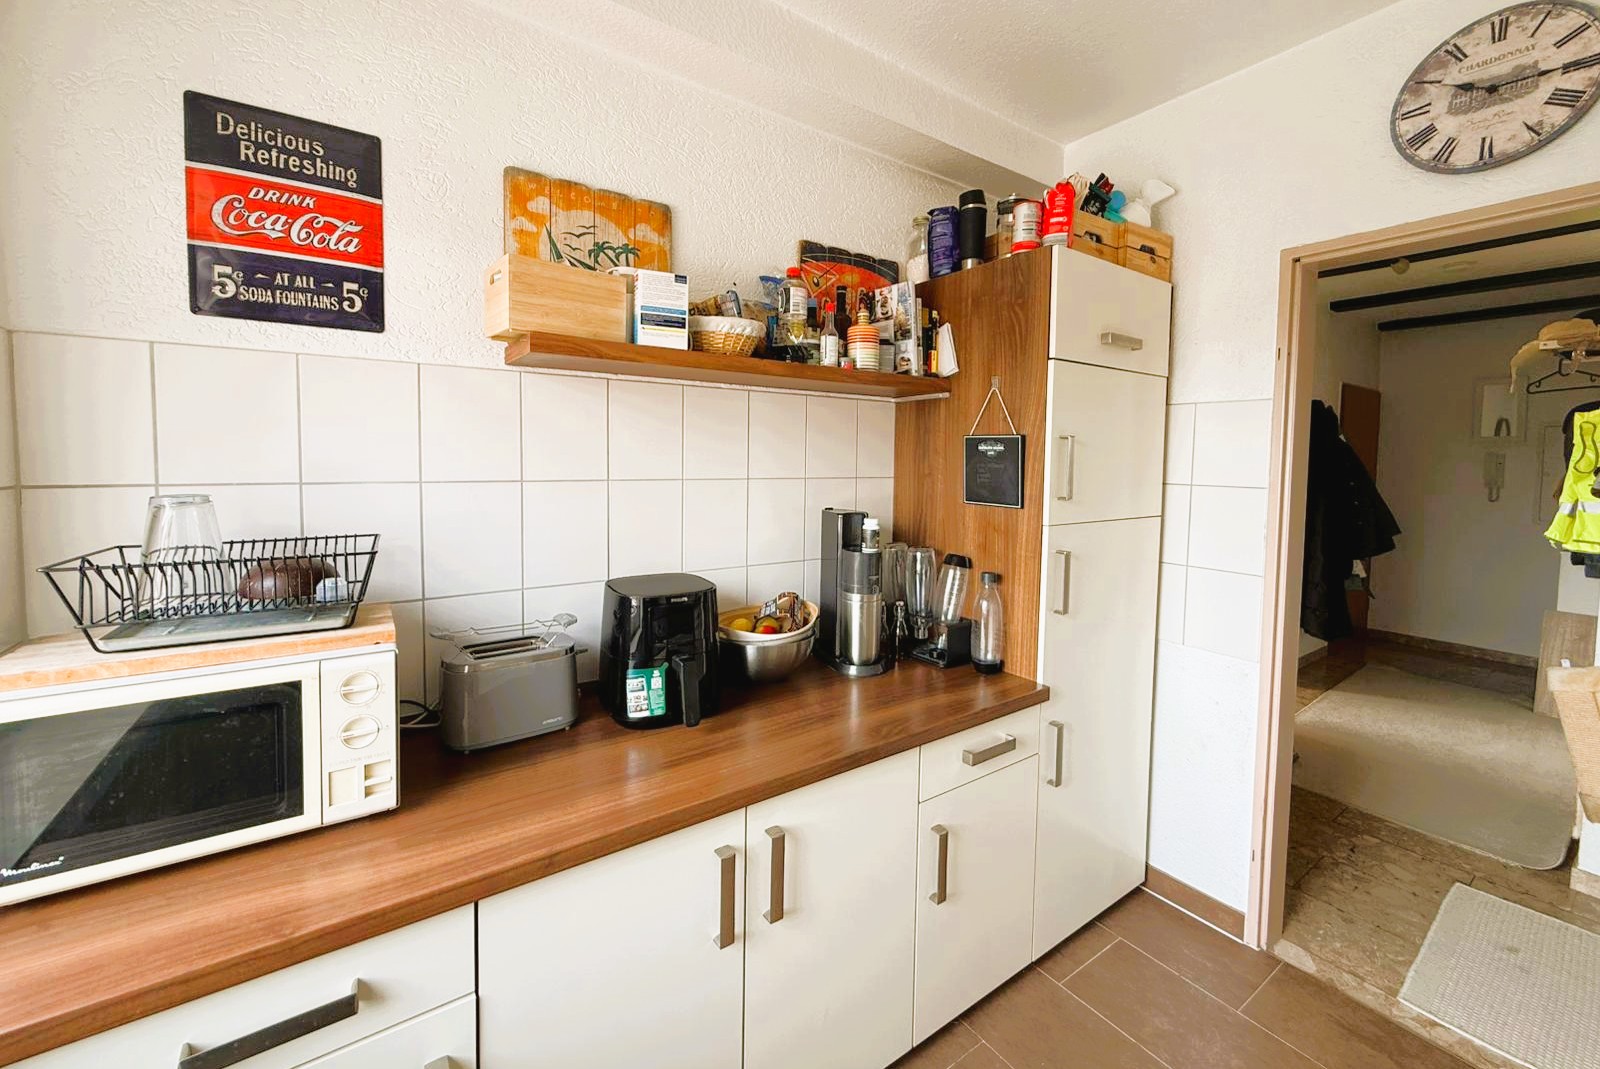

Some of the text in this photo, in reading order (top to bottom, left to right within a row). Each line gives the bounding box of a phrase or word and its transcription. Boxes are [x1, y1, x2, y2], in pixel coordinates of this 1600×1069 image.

[1458, 43, 1537, 74] CHARDONNAY
[216, 111, 324, 157] Delicious
[239, 140, 358, 188] Refreshing
[248, 187, 317, 208] DRINK
[274, 272, 316, 289] AT ALL
[239, 285, 340, 311] SODA FOUNTAINS
